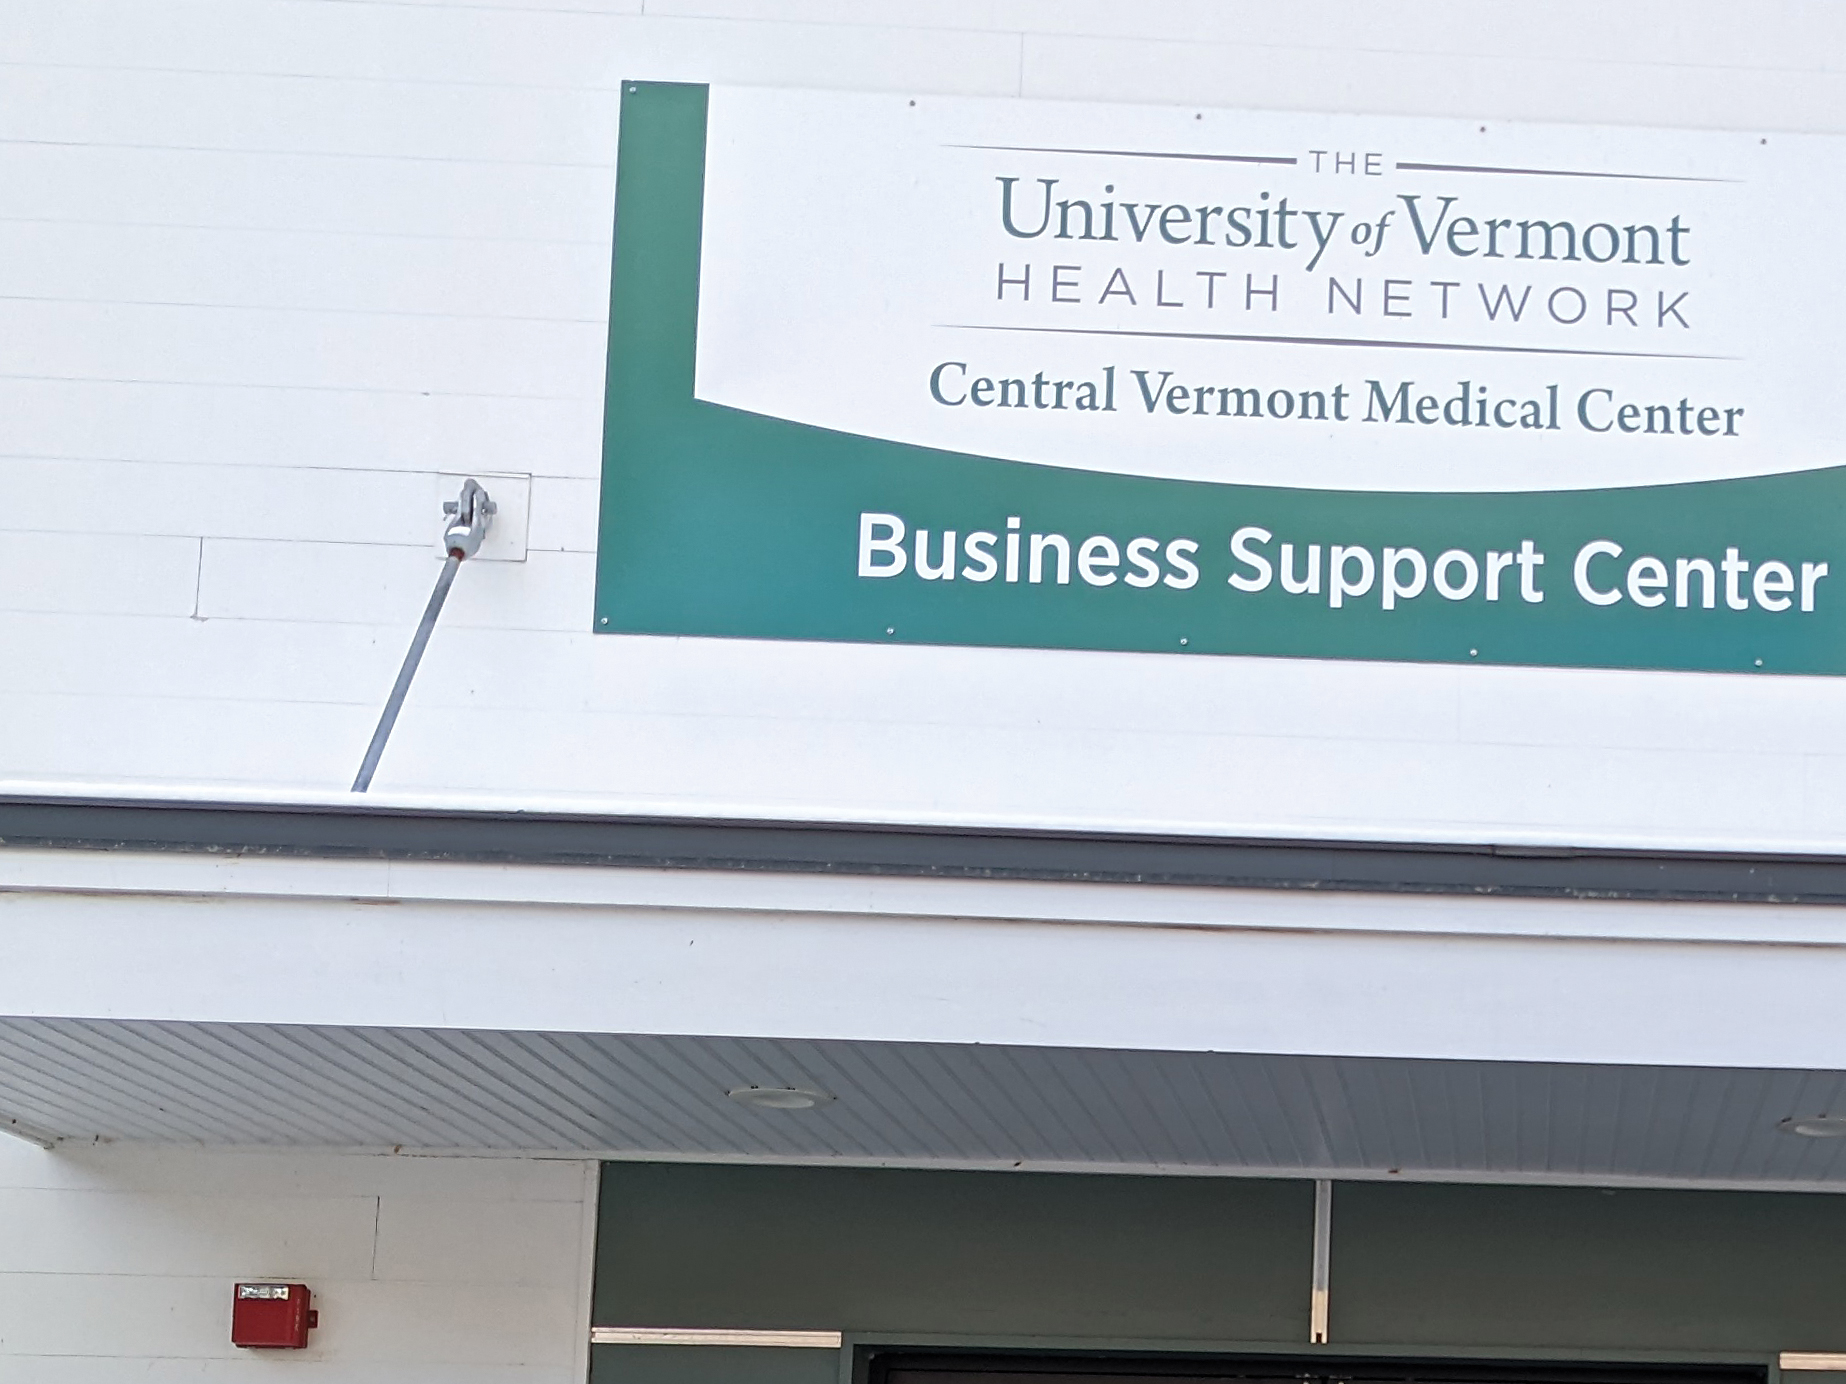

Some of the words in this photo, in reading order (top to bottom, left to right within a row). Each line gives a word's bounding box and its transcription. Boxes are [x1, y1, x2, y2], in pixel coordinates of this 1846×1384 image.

[1309, 150, 1382, 176] THE
[995, 176, 1345, 273] University
[1350, 210, 1396, 258] of
[1396, 194, 1691, 267] Vermont
[997, 262, 1278, 312] HEALTH
[1328, 276, 1690, 329] NETWORK
[929, 361, 1117, 412] Central
[1129, 369, 1350, 422] Vermont
[1362, 379, 1560, 430] Medical
[1577, 388, 1745, 437] Center
[858, 512, 1199, 590] Business
[1227, 526, 1545, 610] Support
[1573, 540, 1828, 612] Center
